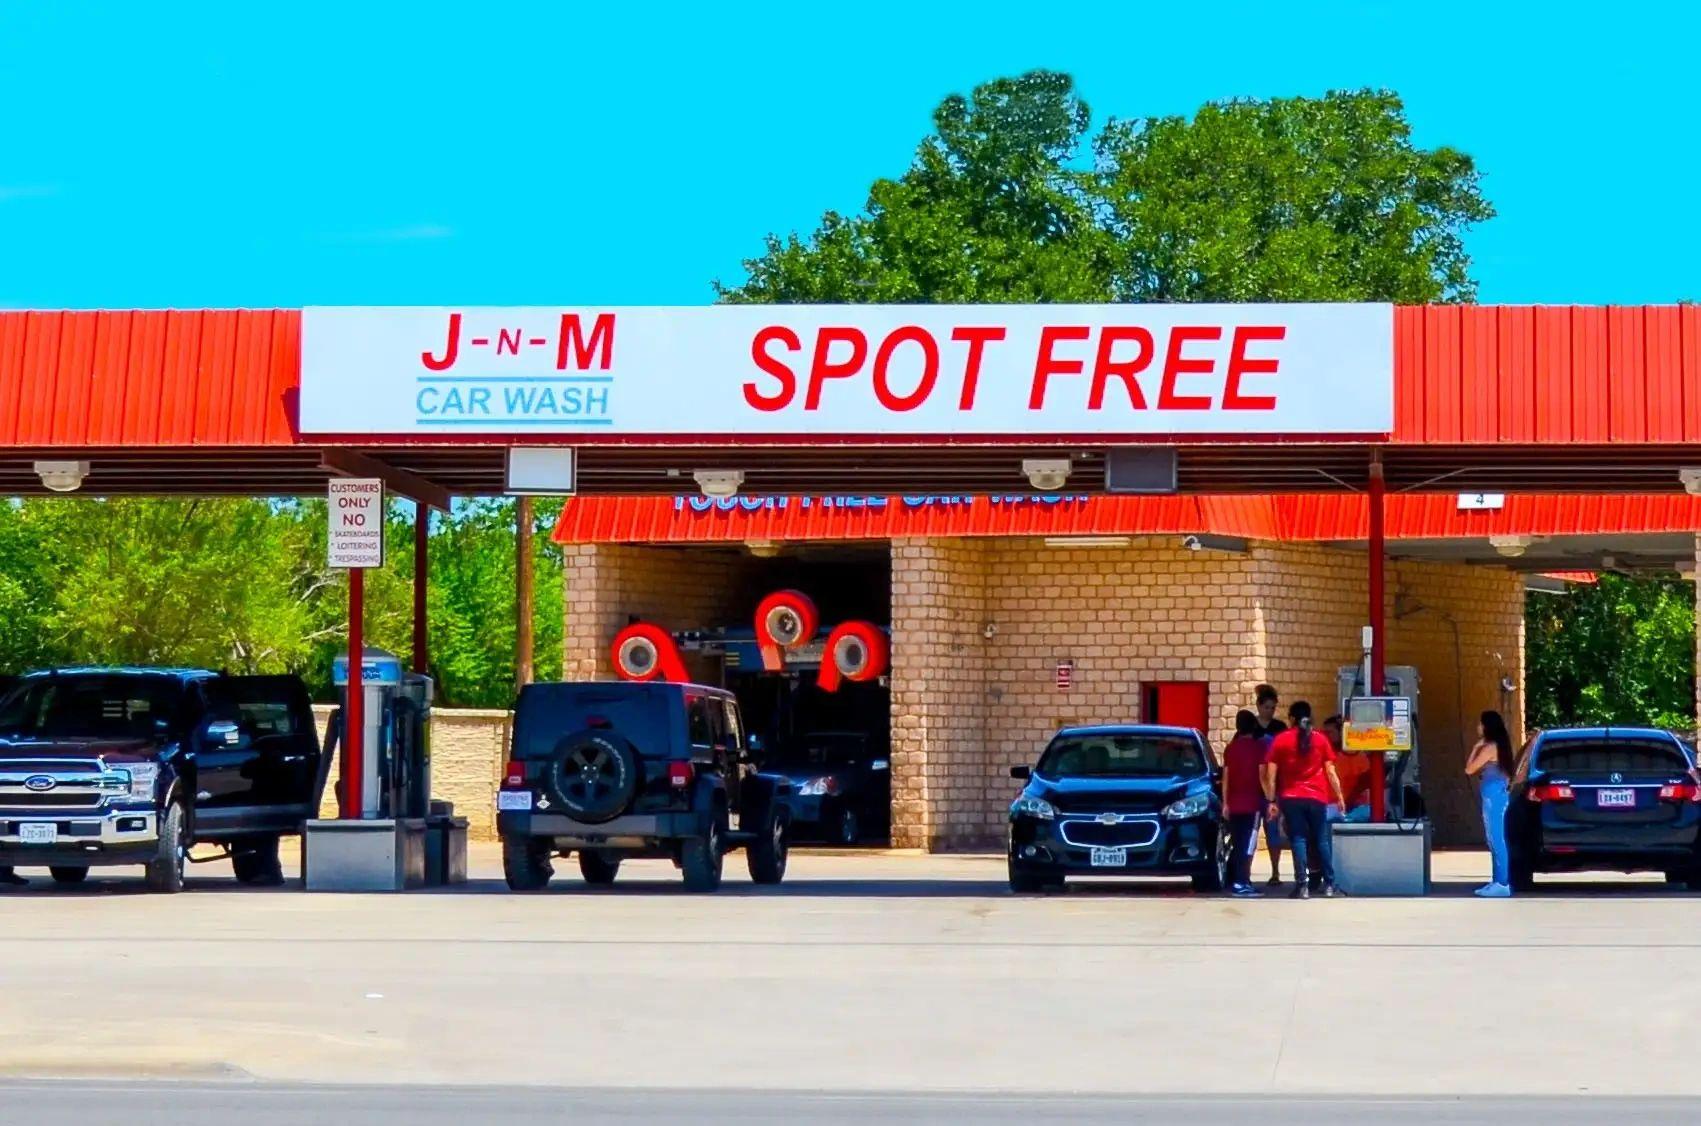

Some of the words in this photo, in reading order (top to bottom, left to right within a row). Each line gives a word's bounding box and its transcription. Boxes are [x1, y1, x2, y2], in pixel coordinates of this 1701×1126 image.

[743, 326, 1006, 412] SPOT
[1028, 327, 1287, 411] FREE
[416, 386, 492, 416] CAR
[504, 386, 609, 417] WASH
[330, 483, 379, 494] CUSTOMERS
[338, 497, 371, 508] ONLY
[1475, 494, 1485, 505] 4
[343, 513, 366, 526] NO
[337, 542, 377, 550] LOITERING
